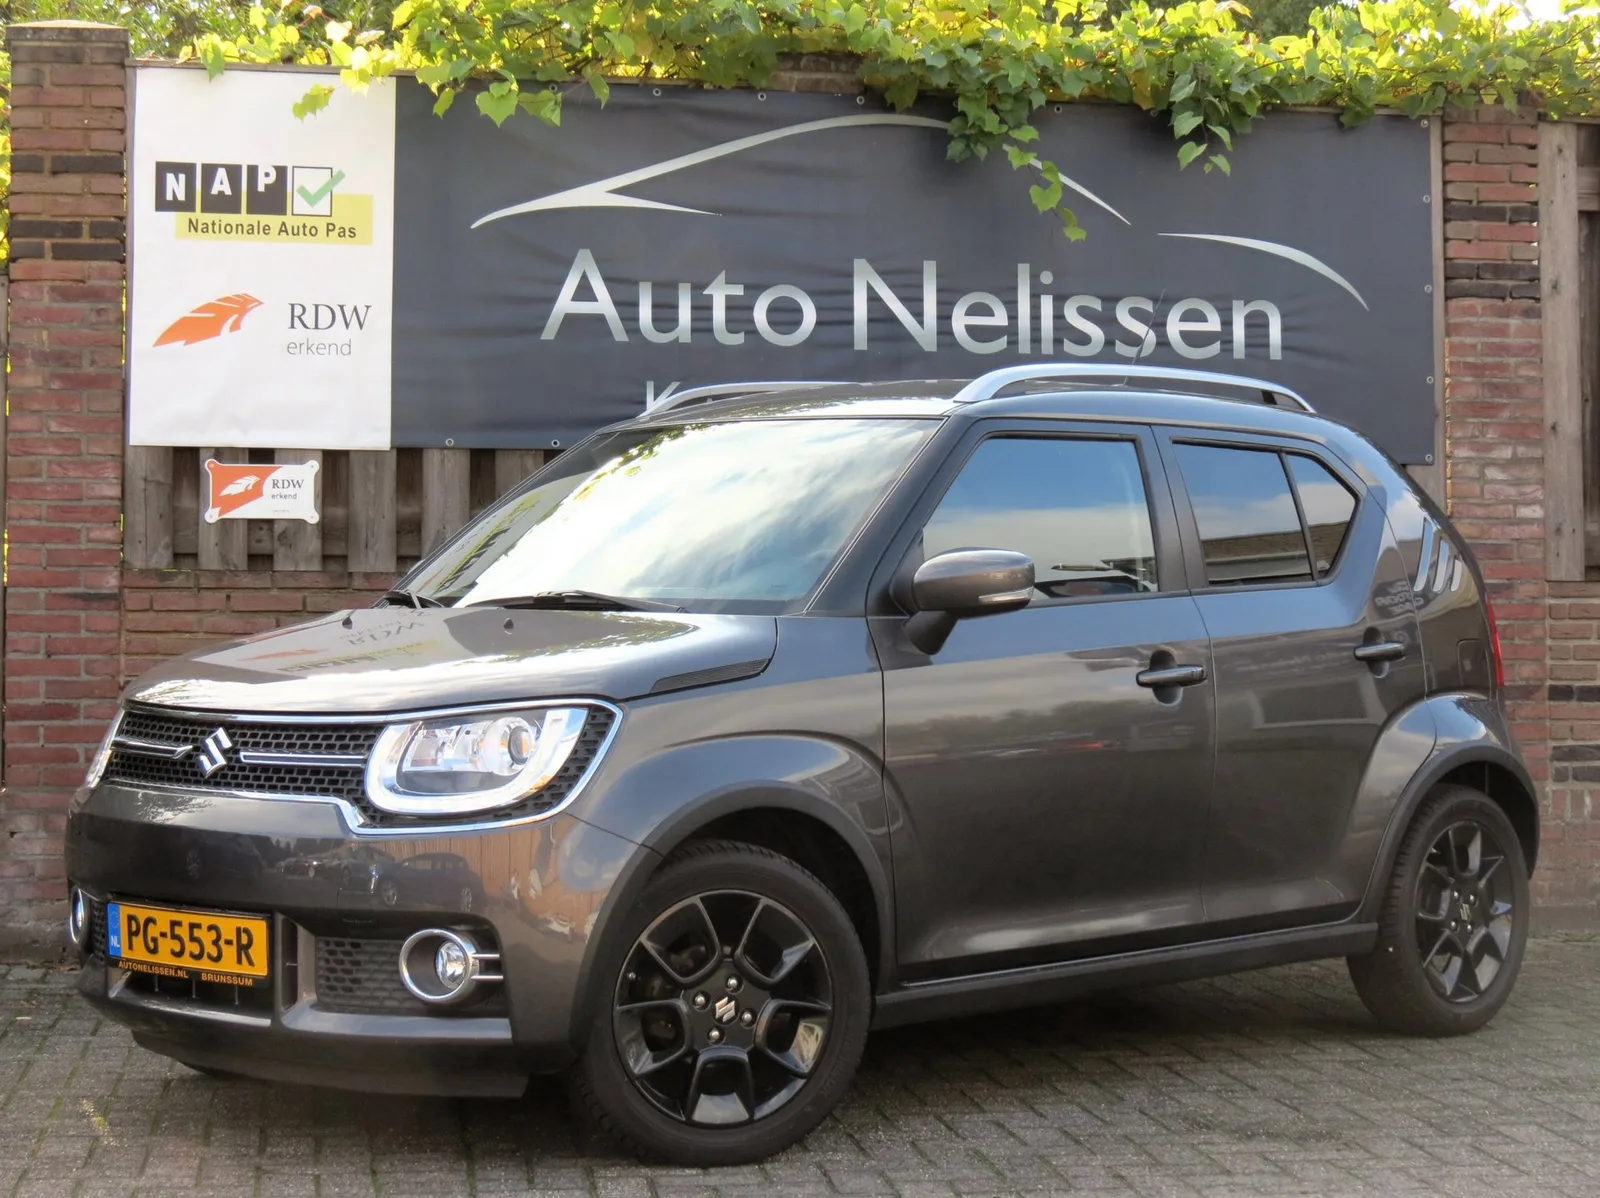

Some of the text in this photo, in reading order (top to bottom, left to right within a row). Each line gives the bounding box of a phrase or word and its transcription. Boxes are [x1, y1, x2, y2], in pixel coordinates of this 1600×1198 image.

[165, 165, 277, 201] NAP
[187, 217, 357, 239] Nationale Auto Pas
[287, 302, 372, 331] RDW
[540, 248, 1283, 361] Auto Nelissen
[286, 337, 352, 356] erkend
[271, 478, 304, 490] RDW
[271, 492, 297, 500] erkend
[110, 934, 120, 948] NL
[126, 913, 255, 967] PG-553-R
[118, 960, 253, 986] AUTONELISSEN.NL BRUNSSUM
